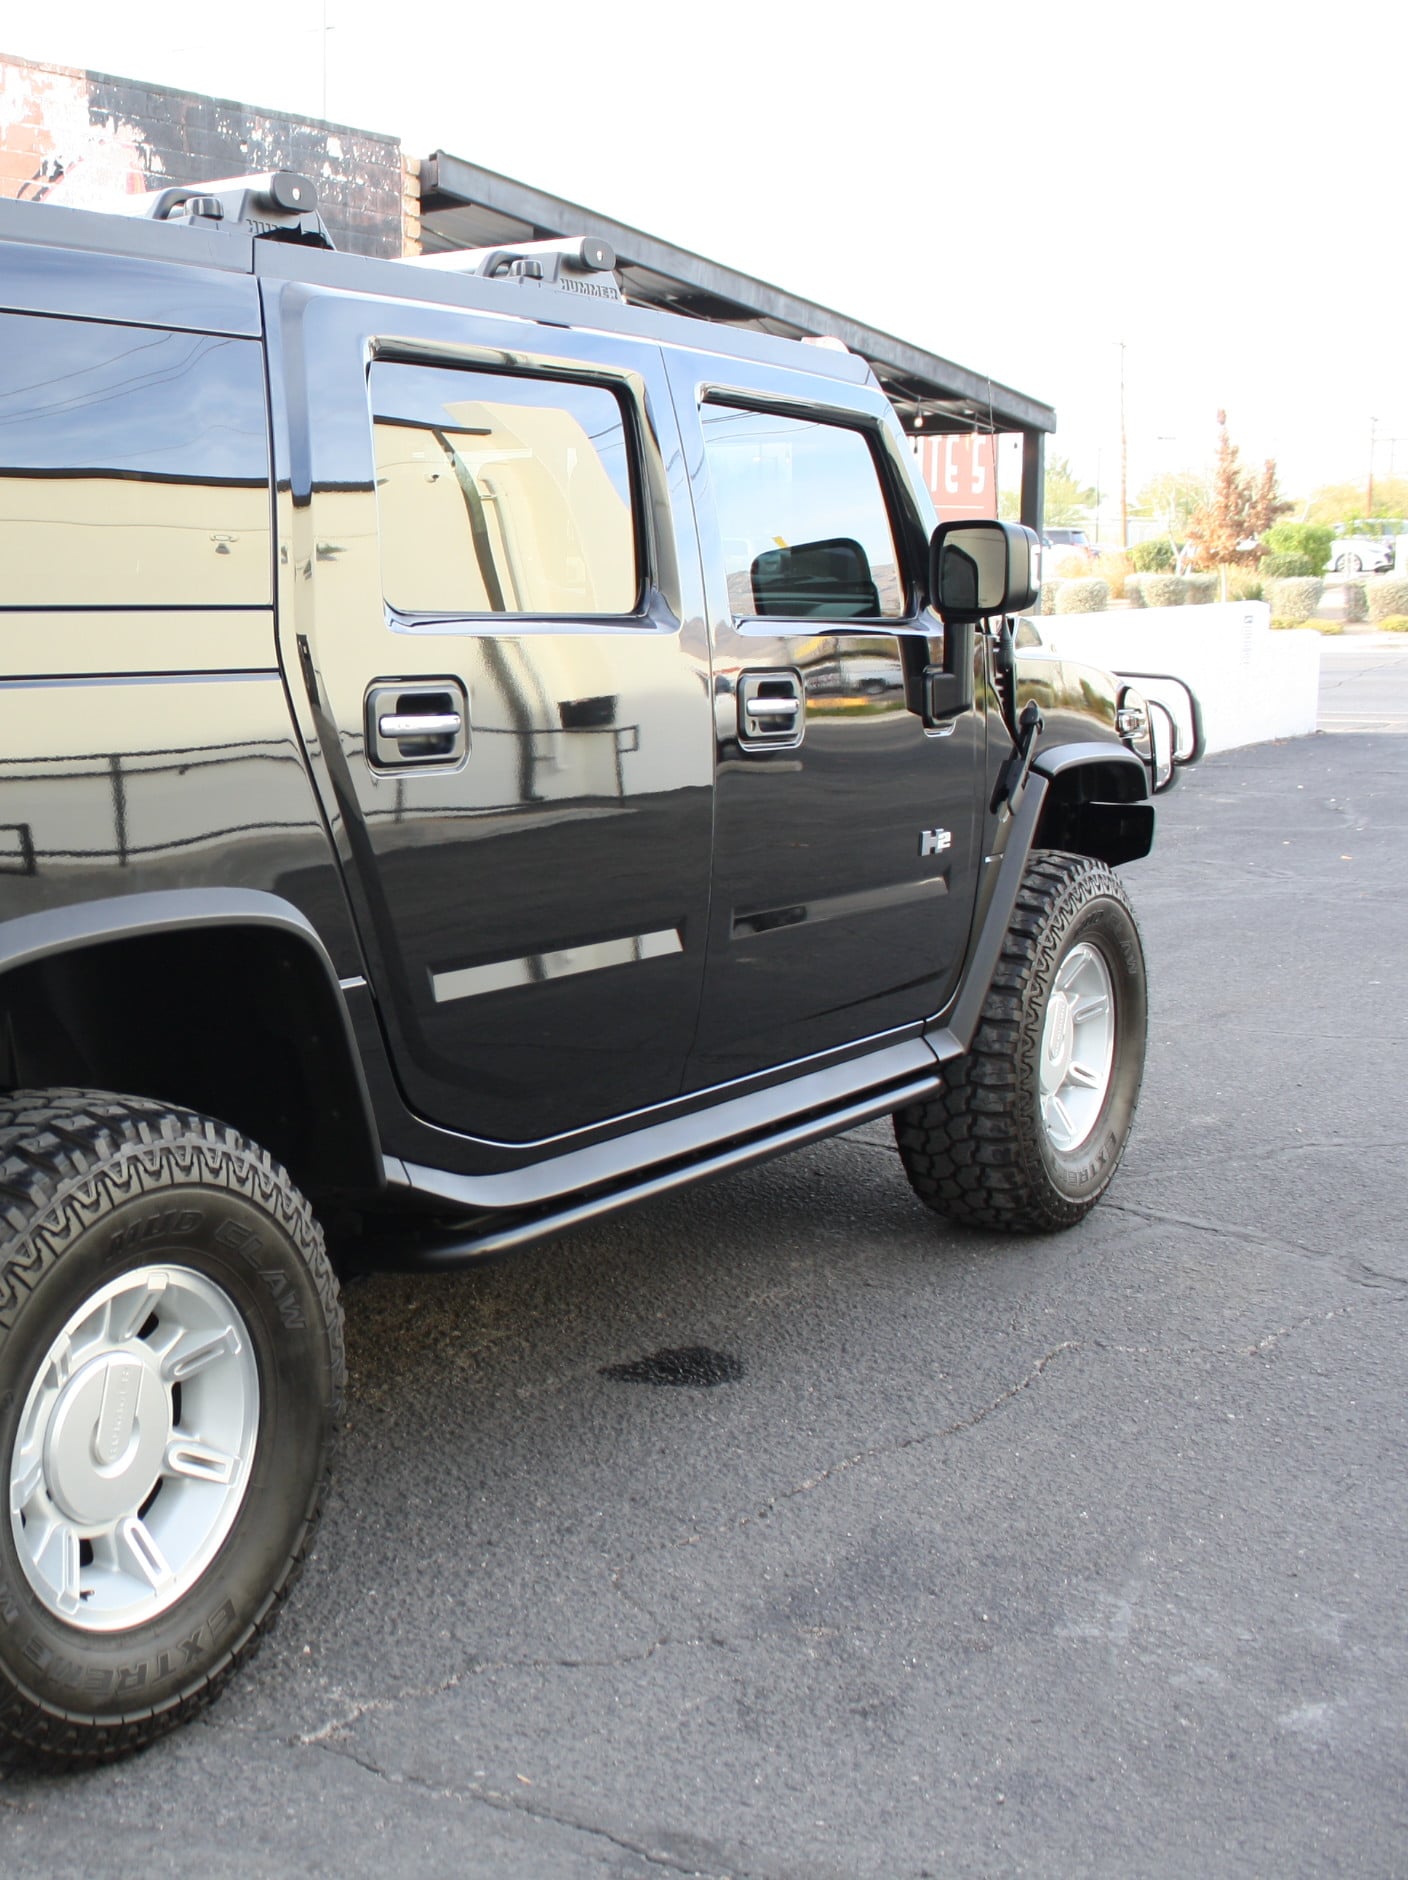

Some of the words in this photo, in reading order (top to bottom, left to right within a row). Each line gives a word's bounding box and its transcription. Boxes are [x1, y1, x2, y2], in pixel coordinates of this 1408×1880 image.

[560, 277, 619, 300] HUMMER
[917, 828, 951, 857] H2
[102, 1208, 206, 1261] MUD
[214, 1218, 307, 1329] CLAW
[22, 1597, 237, 1693] EXTREME
